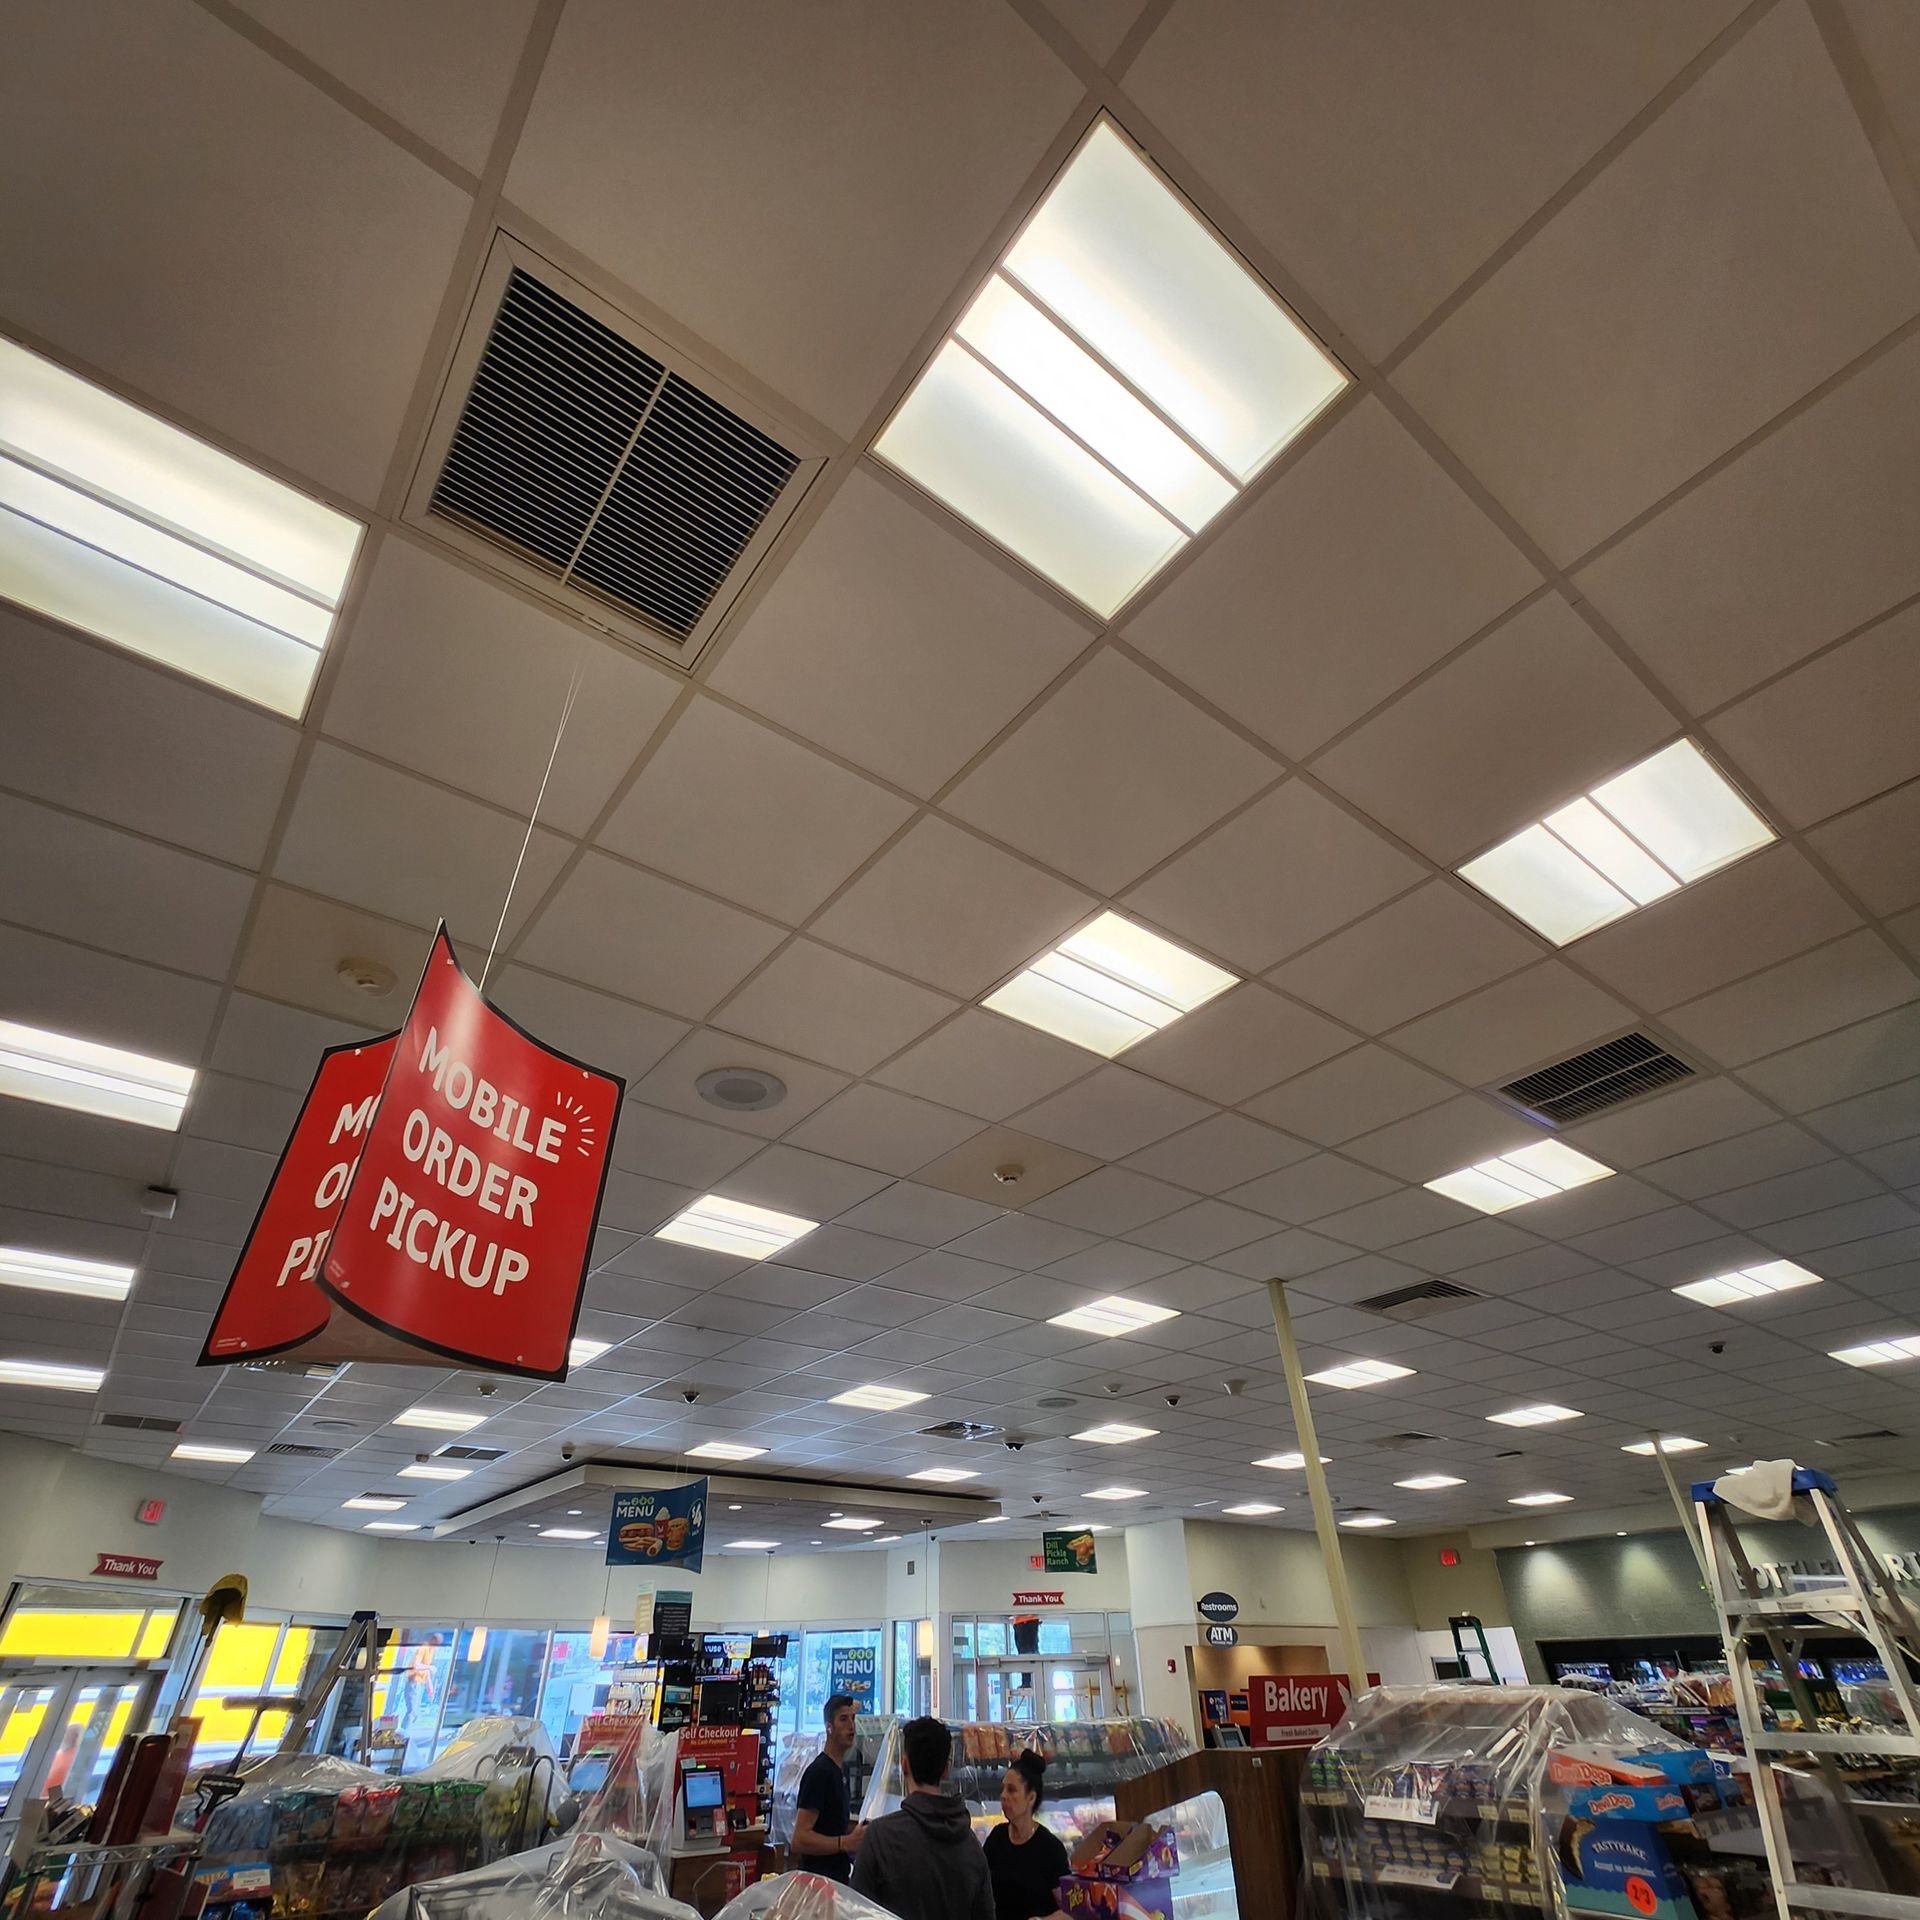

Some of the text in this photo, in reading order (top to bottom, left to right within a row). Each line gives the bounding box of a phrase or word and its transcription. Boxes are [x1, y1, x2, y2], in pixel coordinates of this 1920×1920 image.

[418, 1025, 567, 1164] MOBILE
[403, 1108, 538, 1228] ORDER
[369, 1176, 530, 1297] PICKUP
[616, 1505, 655, 1518] MENU
[1046, 1541, 1058, 1549] Dill
[1046, 1549, 1067, 1557] Pickle
[104, 1559, 157, 1575] Thank You
[1018, 1594, 1060, 1604] Thank You
[1201, 1602, 1237, 1611] Restrooms
[1210, 1626, 1233, 1641] ATM
[833, 1659, 874, 1674] MENU
[1264, 1678, 1329, 1718] Bakery
[680, 1725, 739, 1739] Self Checkout
[1589, 1793, 1634, 1814] Devil Dogs
[1592, 1839, 1649, 1861] TASTYKAKE
